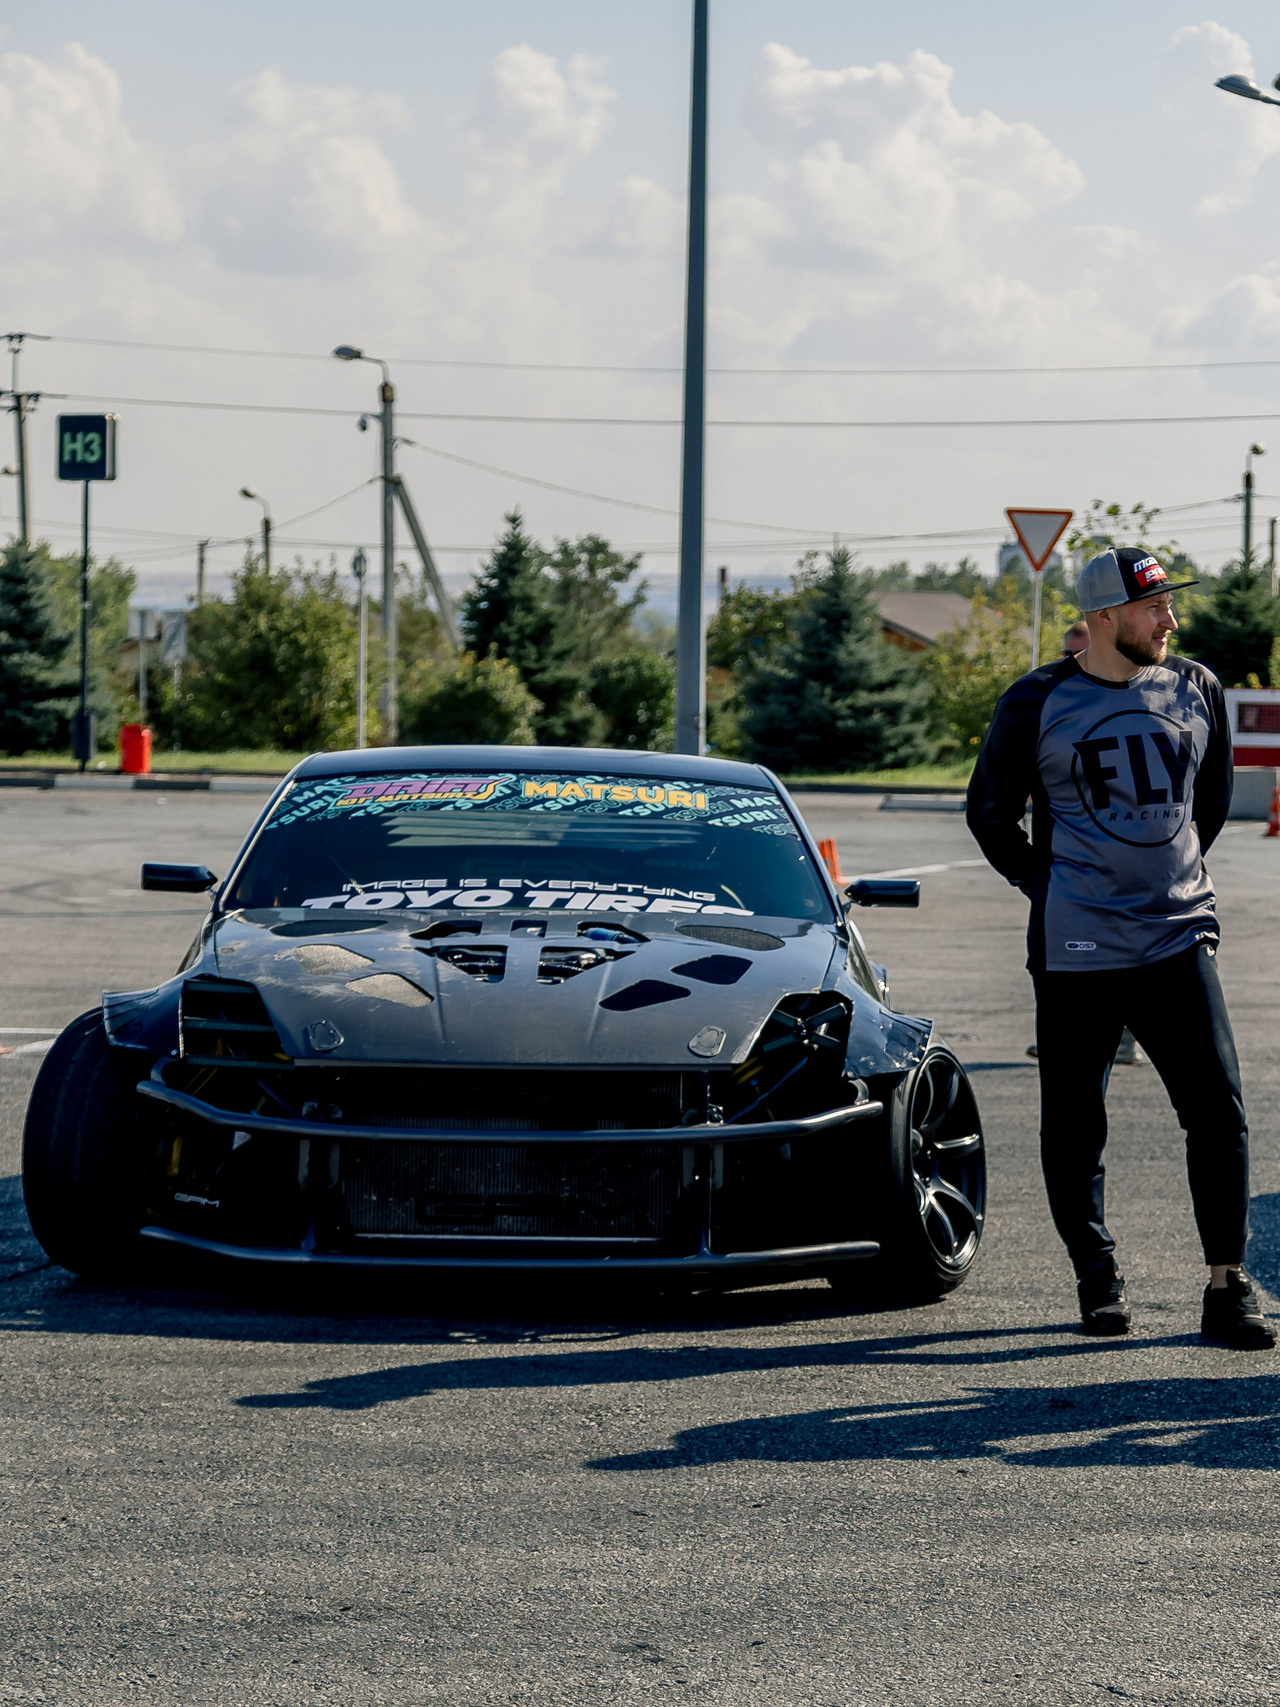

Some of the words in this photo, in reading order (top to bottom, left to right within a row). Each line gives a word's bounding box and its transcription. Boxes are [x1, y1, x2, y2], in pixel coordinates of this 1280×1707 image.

[63, 431, 102, 463] H3
[1071, 731, 1192, 811] FLY
[341, 778, 511, 799] DRIFT
[524, 782, 706, 809] MATSURI
[1109, 809, 1180, 821] RACING
[341, 878, 448, 893] IMAGE
[459, 878, 488, 888] IS
[300, 889, 514, 910] TOYO
